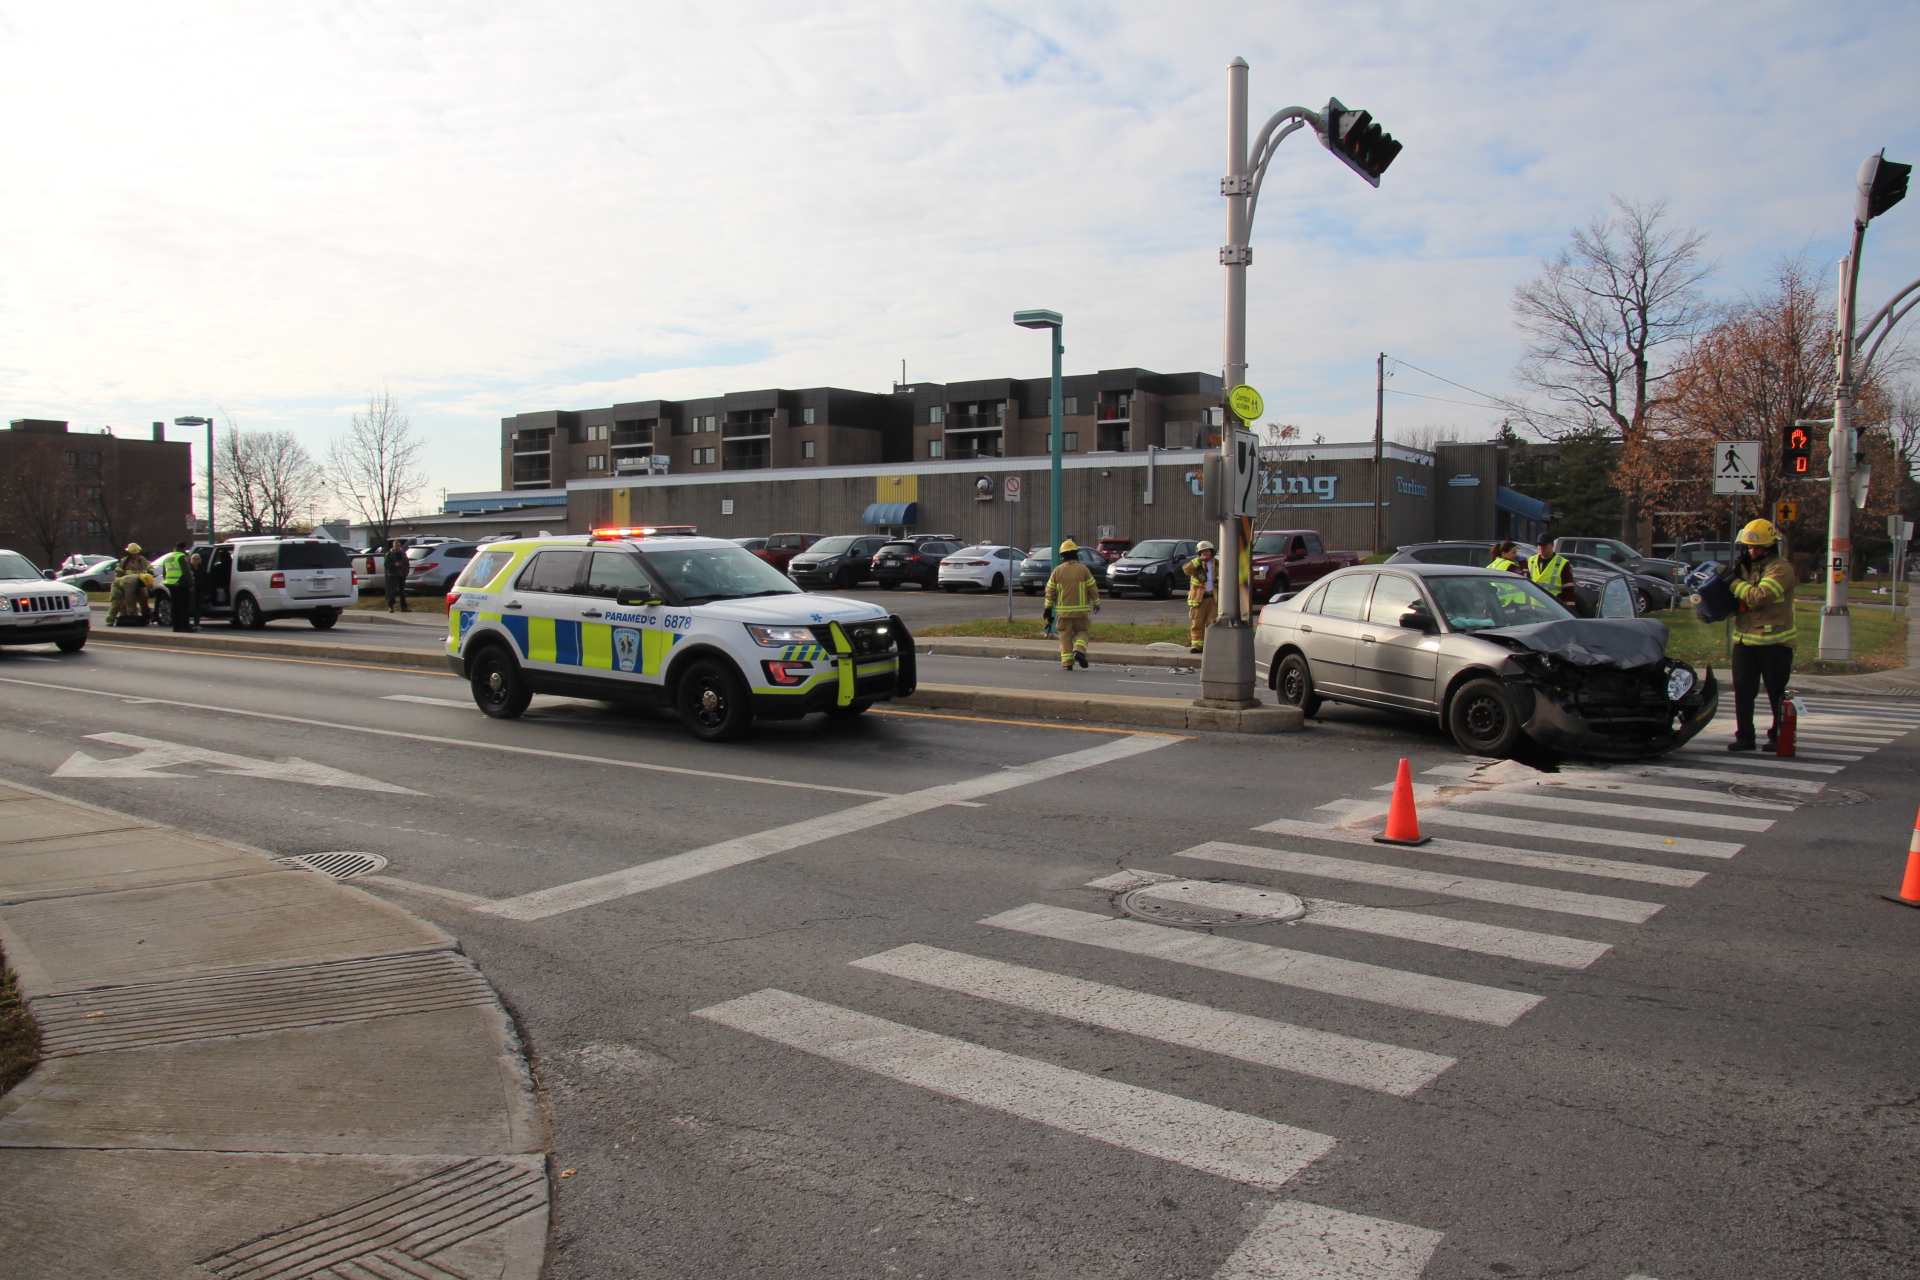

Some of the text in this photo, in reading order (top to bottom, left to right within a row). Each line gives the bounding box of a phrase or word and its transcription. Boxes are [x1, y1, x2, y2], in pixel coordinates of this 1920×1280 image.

[1796, 457, 1806, 471] 0
[1185, 469, 1338, 500] Cling
[1396, 475, 1428, 501] Curling
[664, 614, 693, 630] 6878
